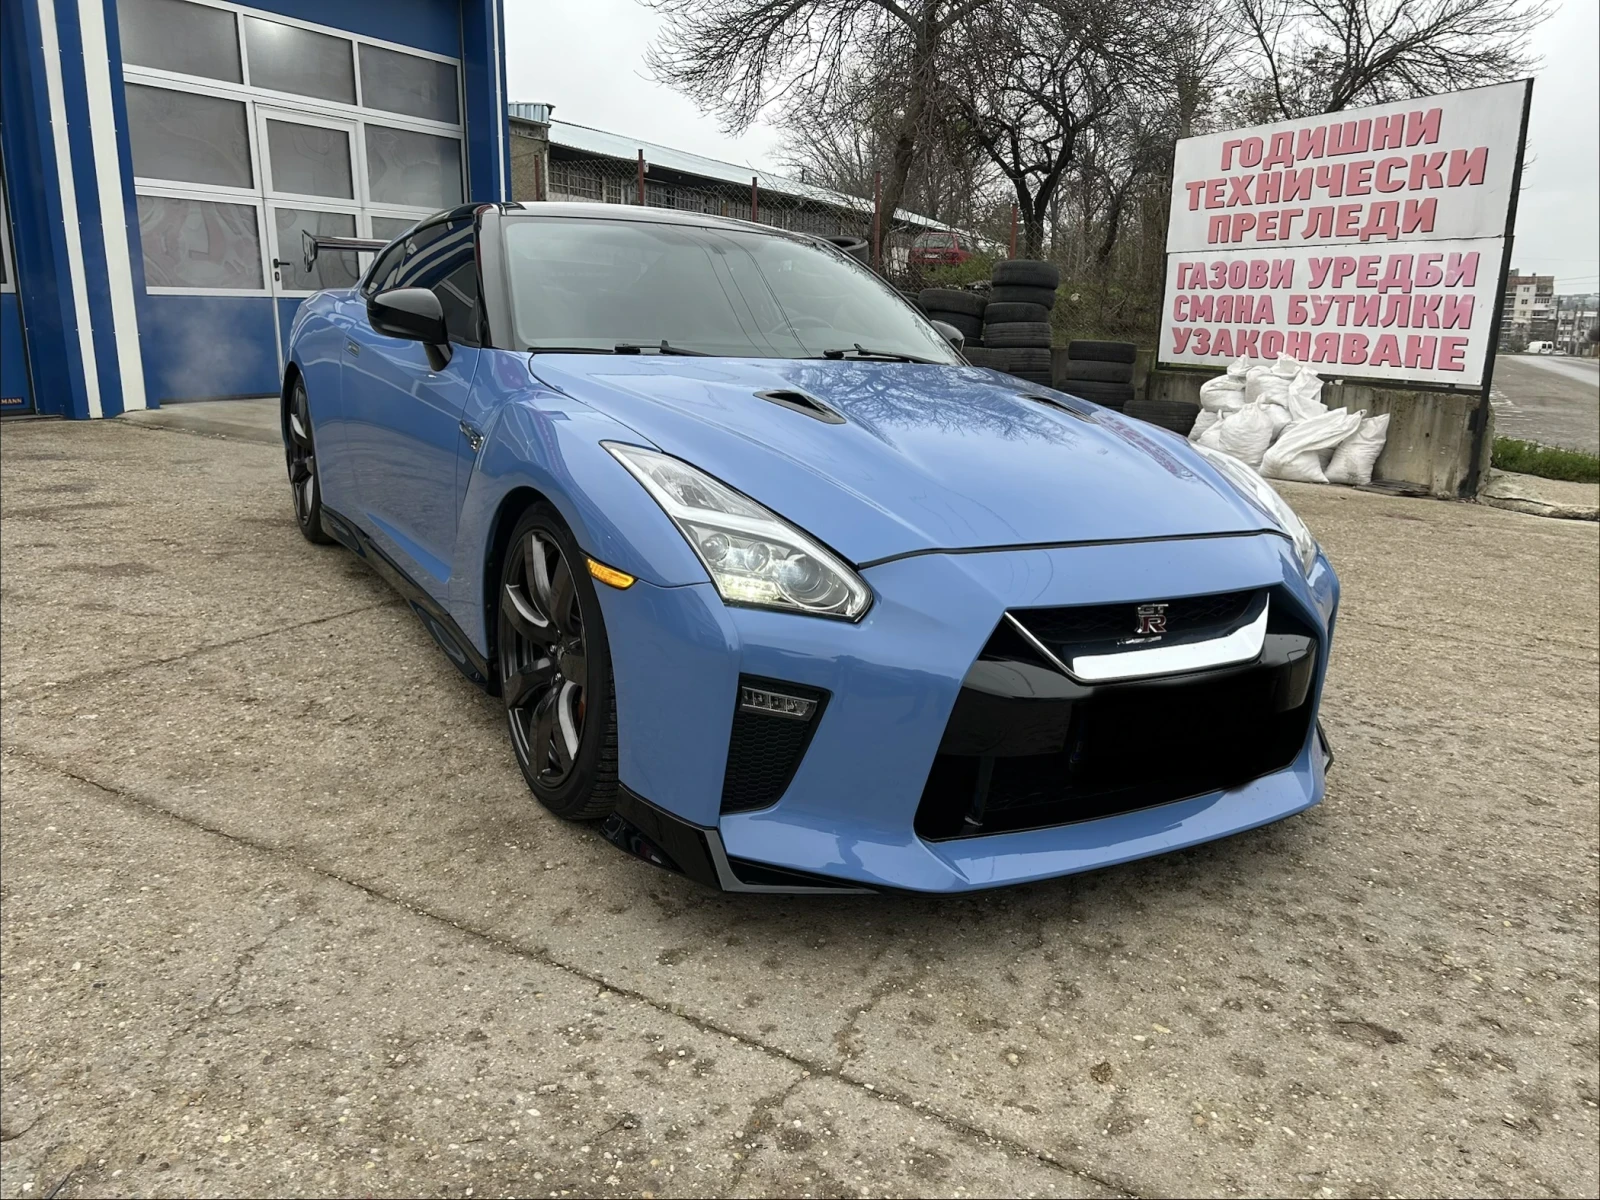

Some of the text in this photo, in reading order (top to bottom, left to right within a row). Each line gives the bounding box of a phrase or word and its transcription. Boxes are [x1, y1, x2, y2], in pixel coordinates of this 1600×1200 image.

[1220, 108, 1442, 170] ГОДИШНИ
[1185, 147, 1488, 211] ТЕХНИЧЕСКИ
[1207, 198, 1438, 244] ПРЕГЛЕДИ
[1176, 252, 1481, 294] ГАЗОВИ УРЕДБИ
[1173, 294, 1476, 329] СМЯНА БУТИЛКИ
[1172, 327, 1469, 371] УЗАКОНЯВАНЕ
